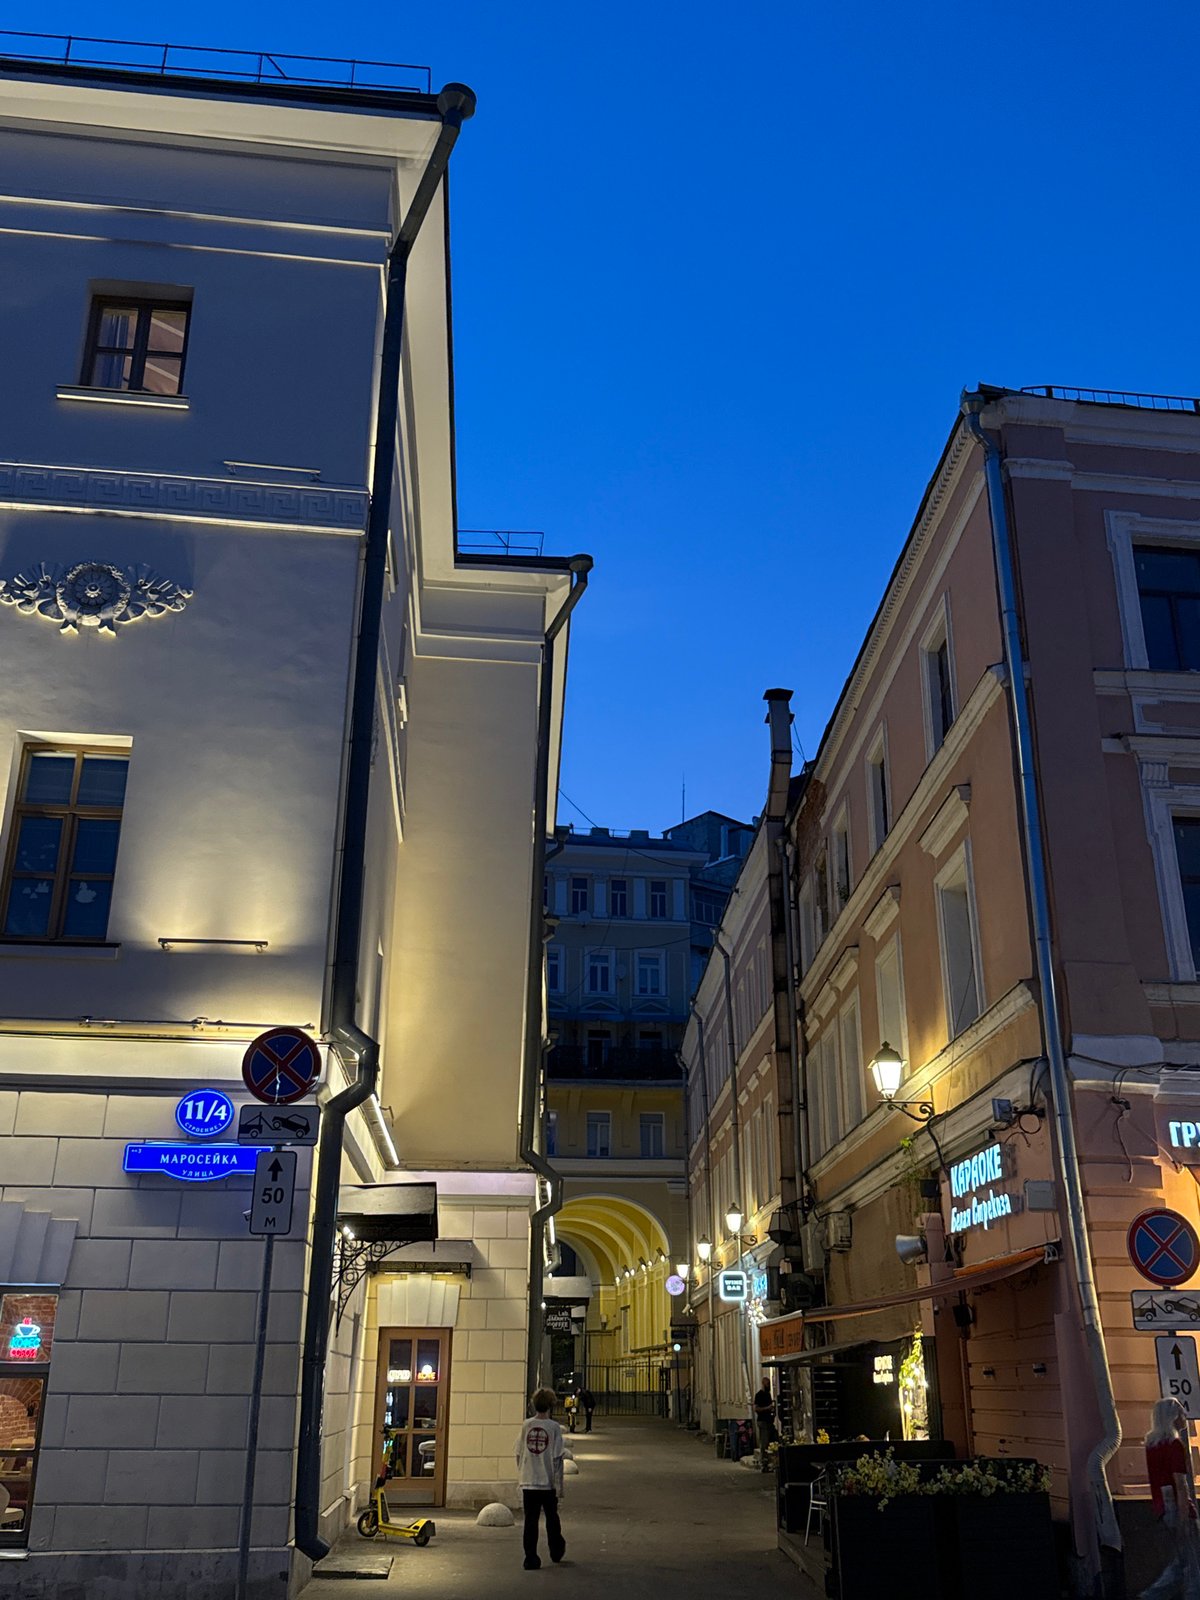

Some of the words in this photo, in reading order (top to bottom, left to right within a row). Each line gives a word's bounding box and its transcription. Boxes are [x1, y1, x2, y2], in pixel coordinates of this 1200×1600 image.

[184, 1100, 228, 1122] 11/4
[184, 1122, 218, 1133] СТРОЕНИЕ
[160, 1152, 238, 1165] МАРОСЕЙКА
[181, 1169, 214, 1177] УЛИЦА
[950, 1143, 1002, 1198] КАРАОКЕ
[261, 1187, 285, 1204] 50
[1169, 1379, 1192, 1395] 50
